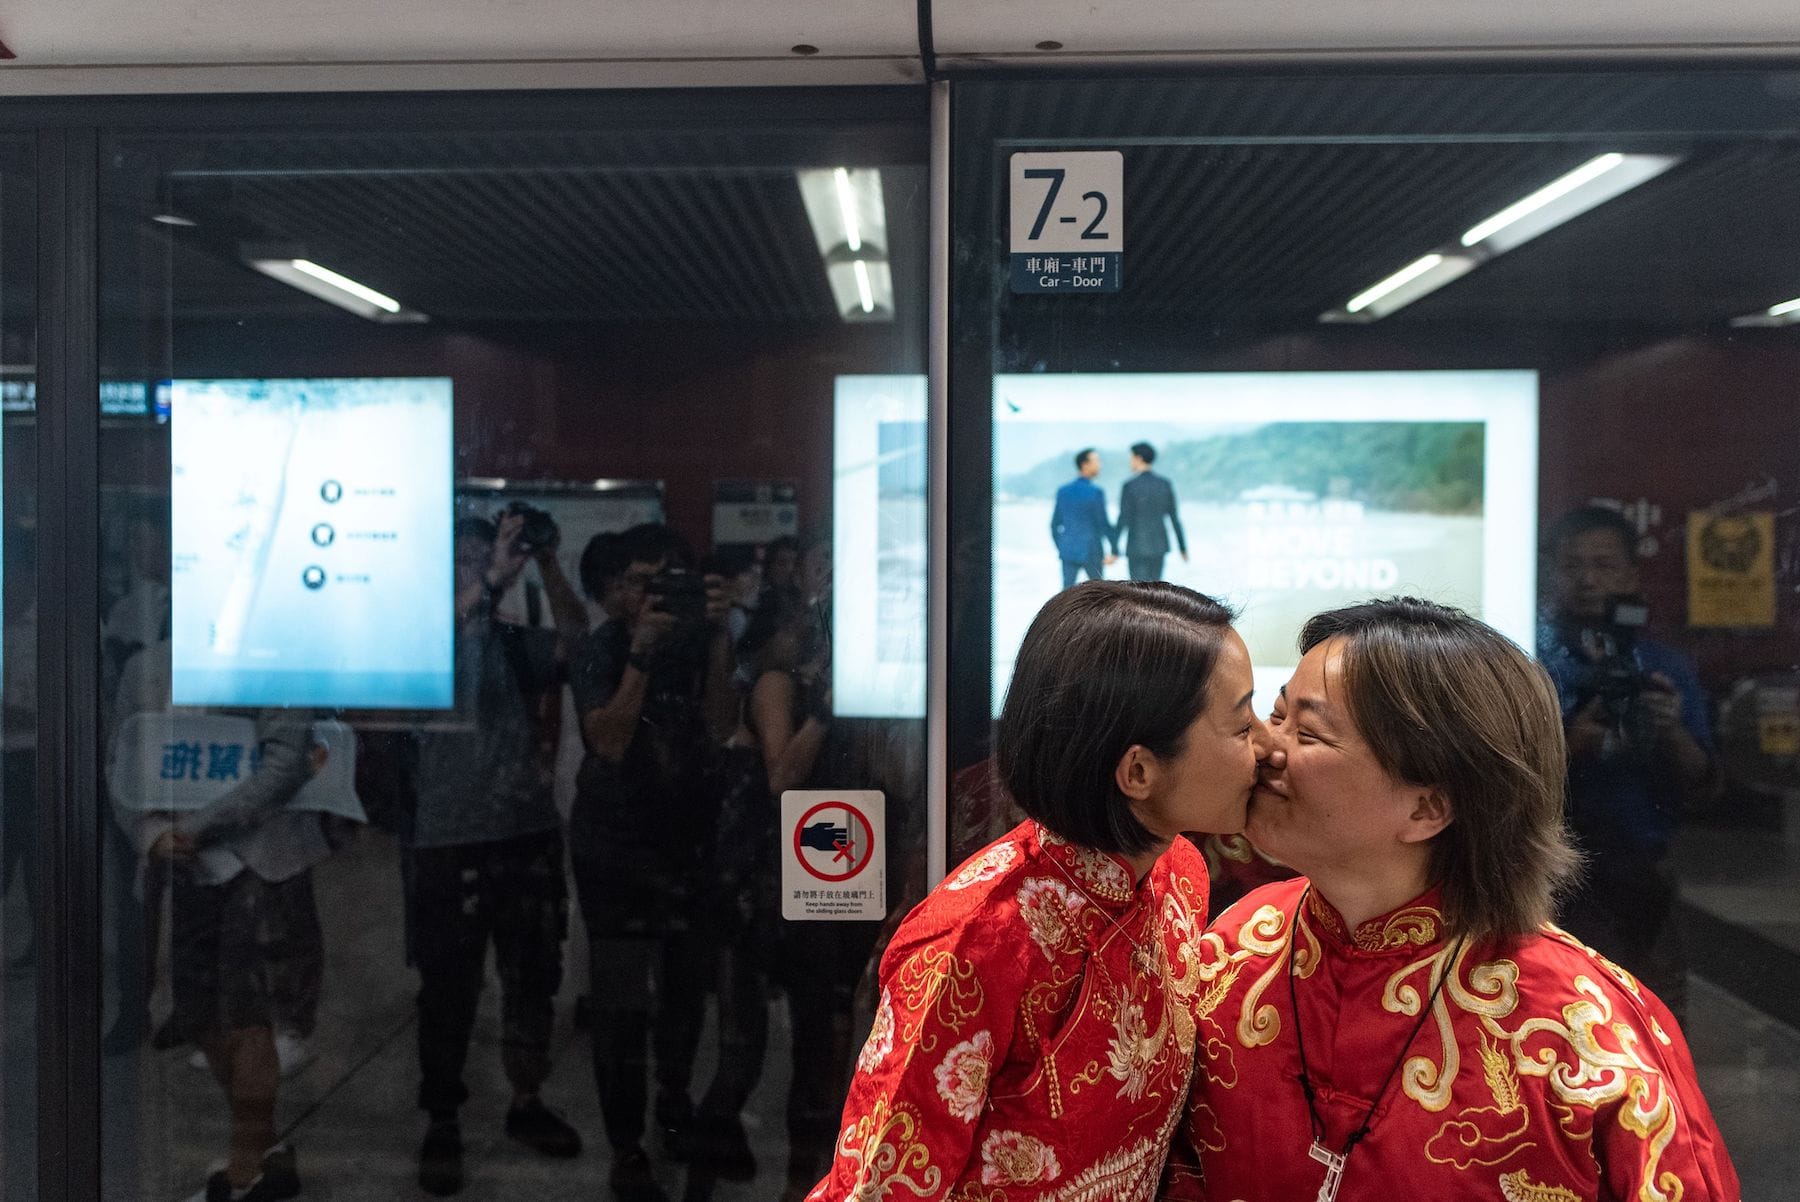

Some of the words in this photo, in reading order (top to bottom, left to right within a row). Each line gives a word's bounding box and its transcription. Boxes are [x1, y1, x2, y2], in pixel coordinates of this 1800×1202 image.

[1024, 169, 1108, 240] 7-2
[1040, 276, 1060, 287] Car
[1073, 276, 1104, 287] Door
[1248, 526, 1353, 556] MOVE
[1248, 558, 1399, 589] BEYOND
